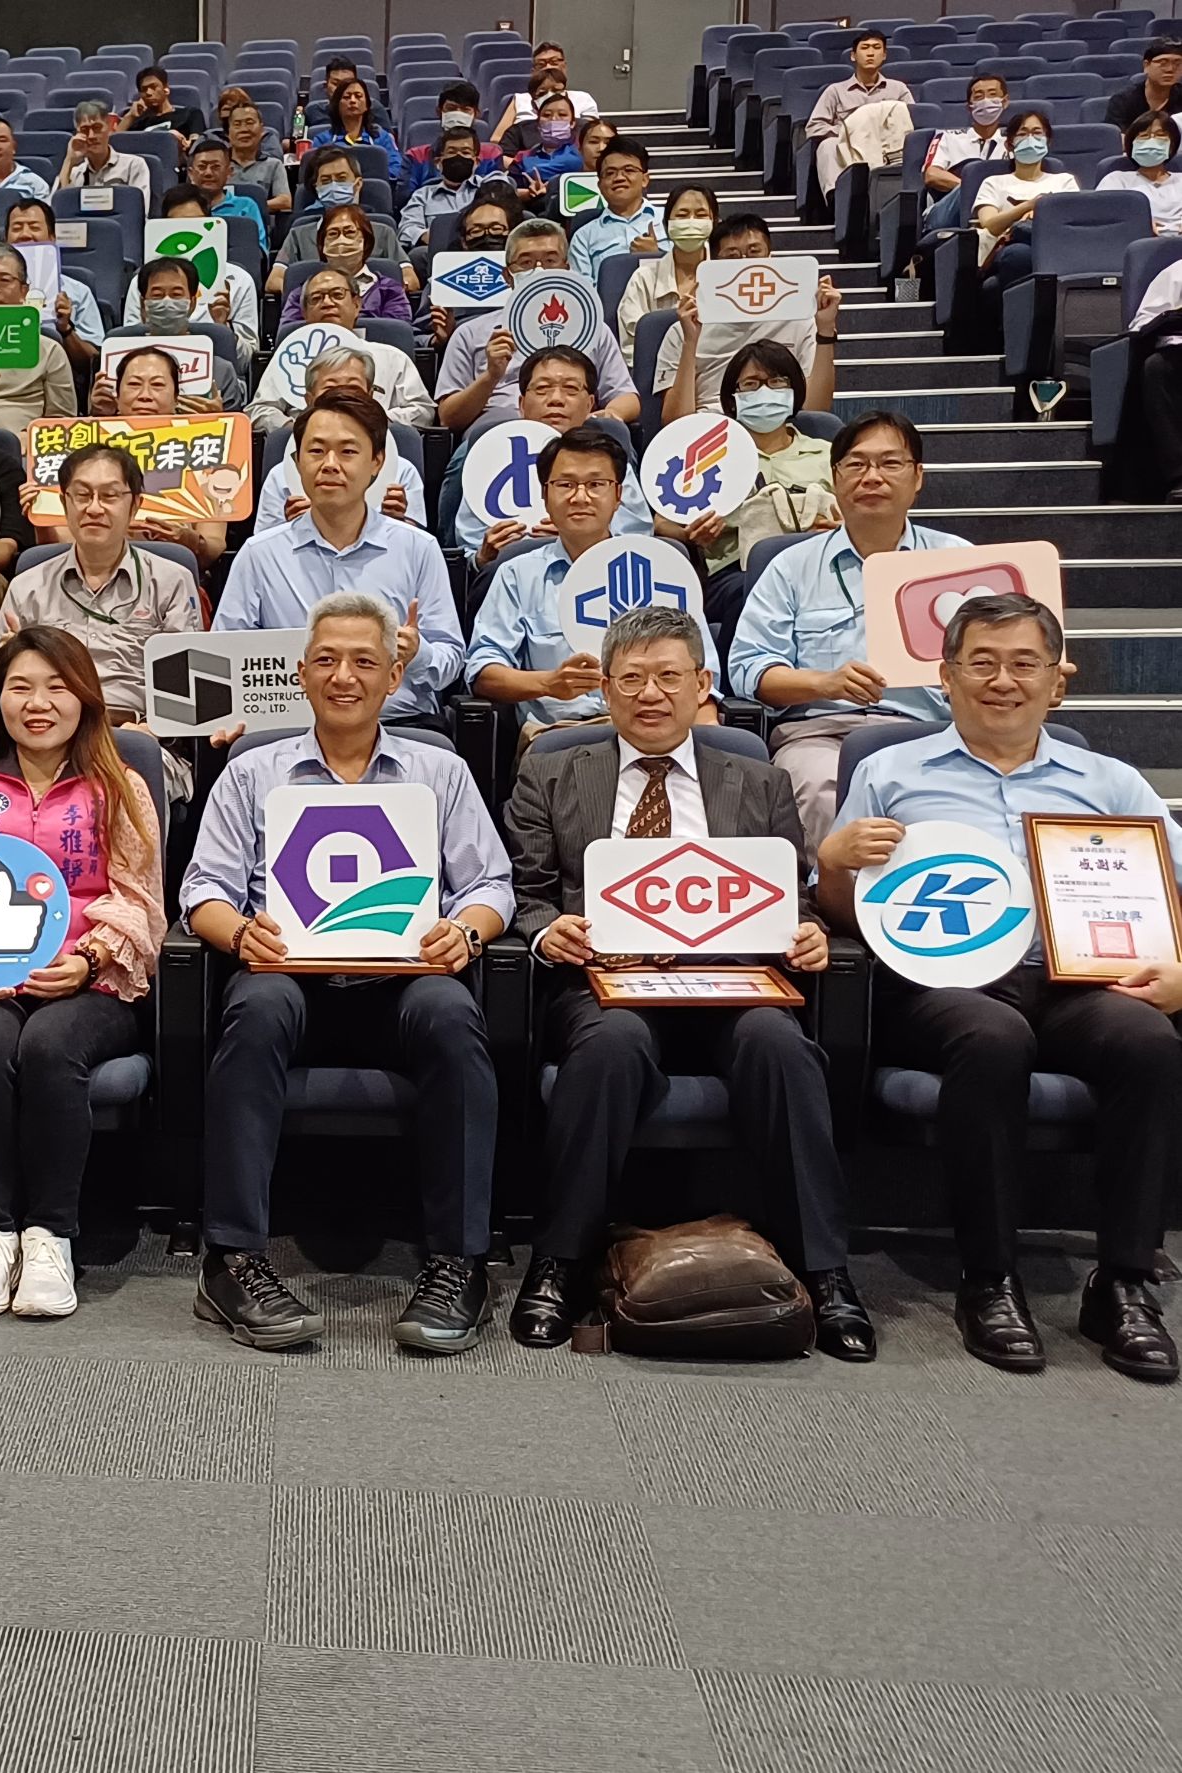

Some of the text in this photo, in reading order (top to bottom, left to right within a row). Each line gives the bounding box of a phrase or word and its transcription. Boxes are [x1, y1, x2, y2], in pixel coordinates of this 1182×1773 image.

[455, 274, 507, 284] RSEA
[37, 421, 98, 454] 共創
[241, 657, 286, 671] JHEN
[242, 673, 300, 688] SHENG
[243, 691, 309, 702] CONSTRUCT
[270, 703, 290, 713] LTD.
[634, 876, 751, 914] CCP
